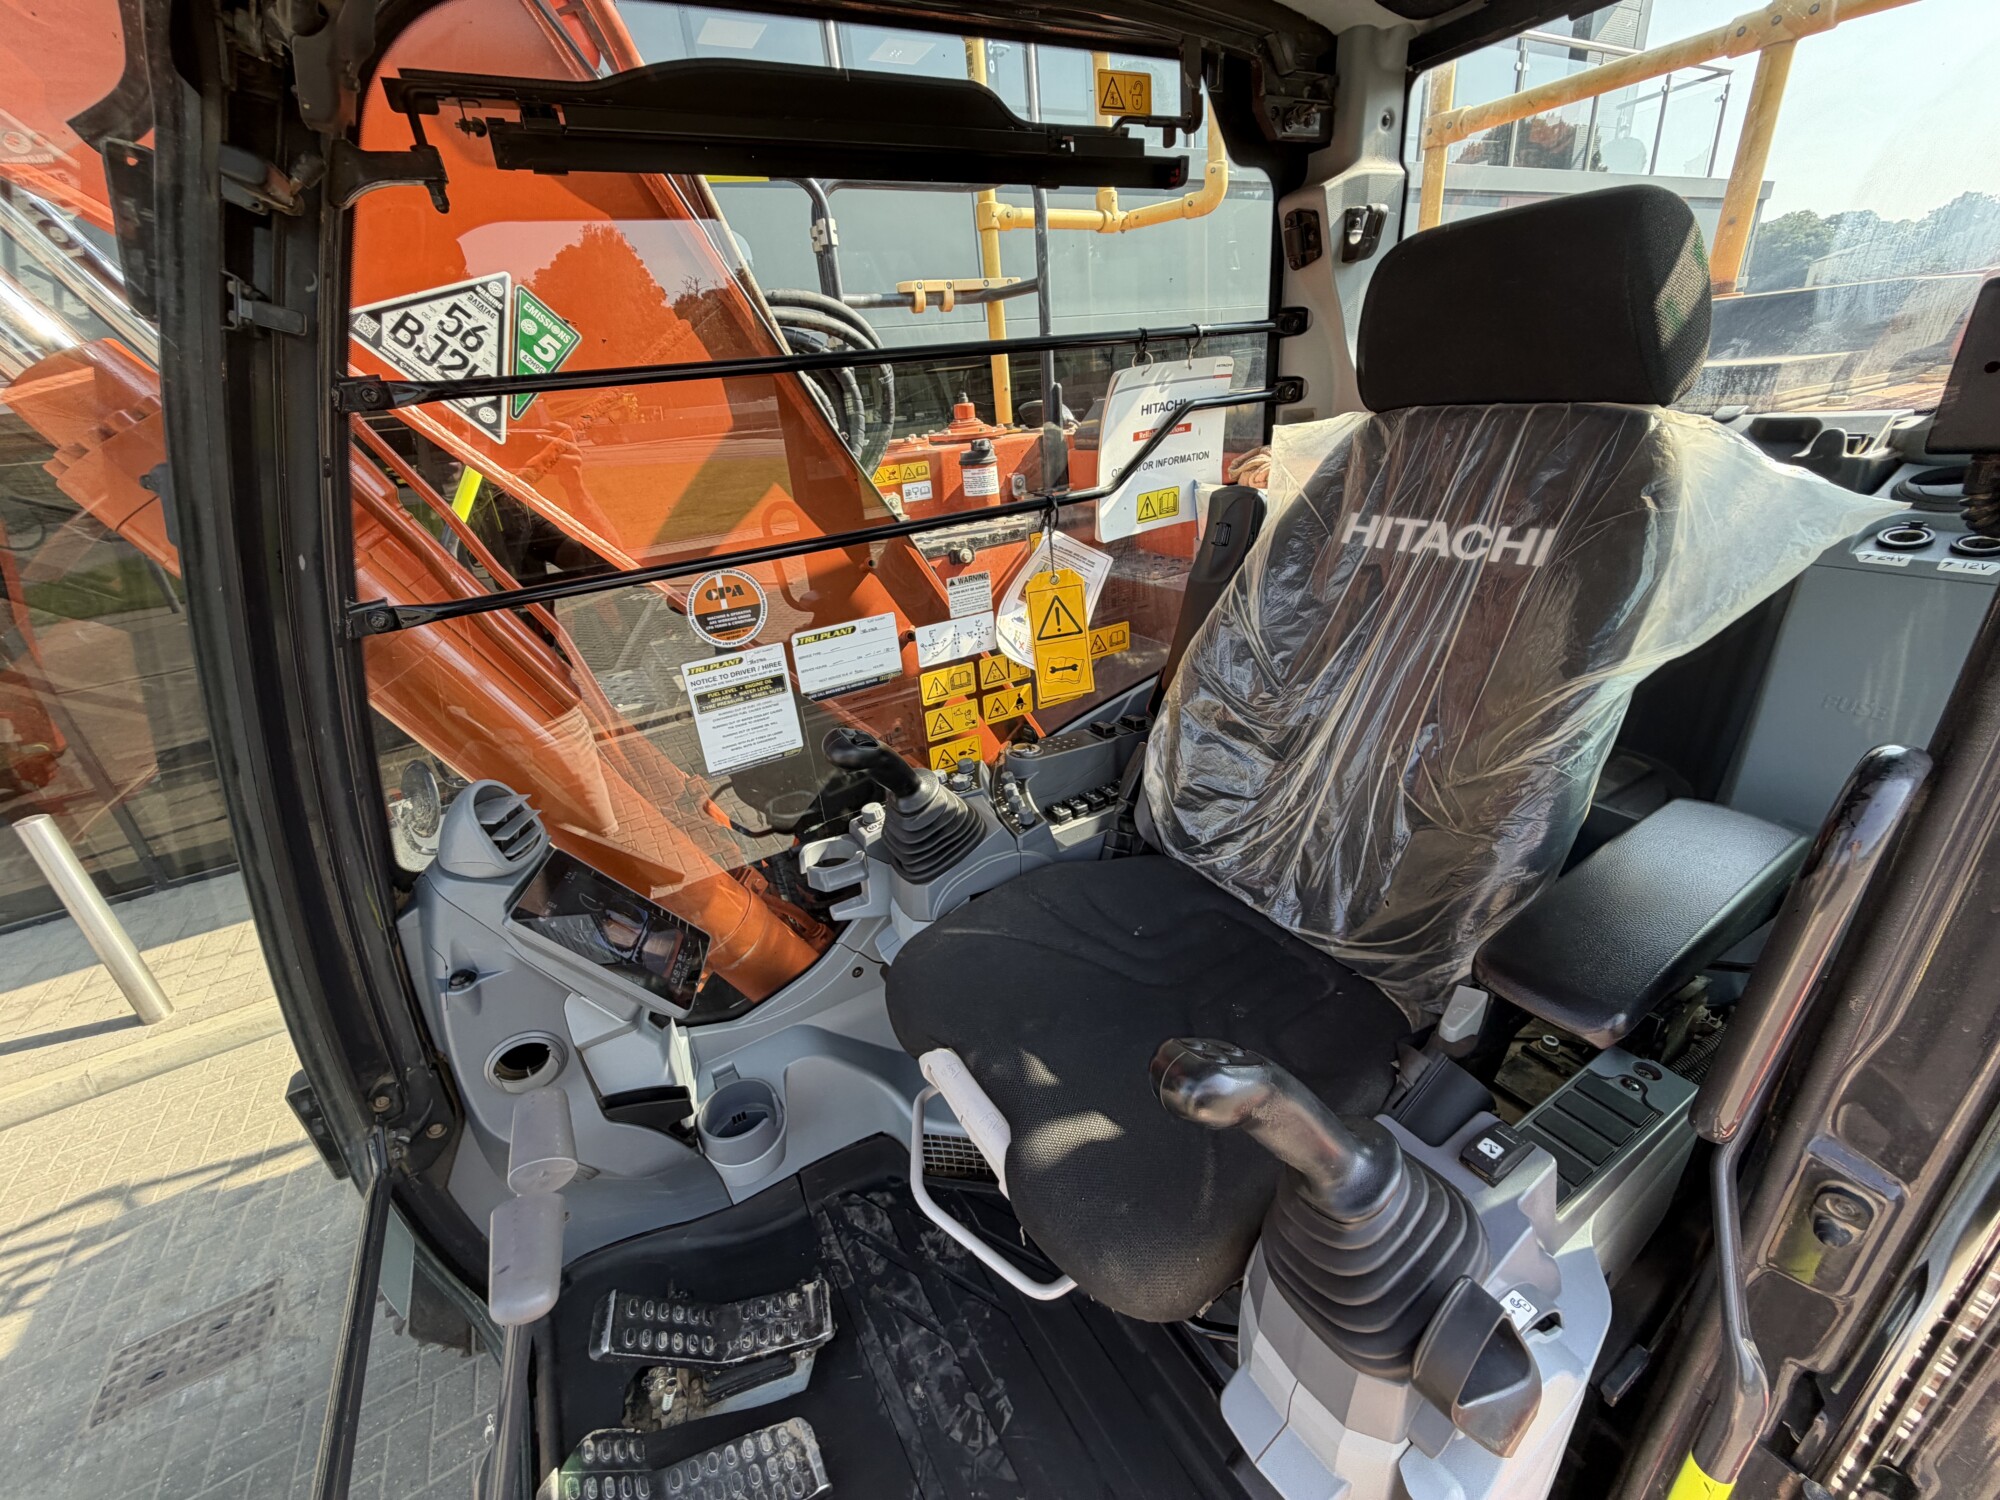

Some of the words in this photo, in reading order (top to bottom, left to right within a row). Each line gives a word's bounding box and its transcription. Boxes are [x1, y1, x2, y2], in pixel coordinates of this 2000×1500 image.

[474, 285, 505, 310] WARNING
[466, 294, 498, 320] DATATAG
[438, 303, 489, 352] 56
[523, 302, 571, 344] EMISSIONS
[533, 334, 562, 362] 5
[1155, 451, 1210, 469] INFORMATION
[1341, 512, 1557, 567] HITACHI
[1877, 554, 1906, 563] 24V
[1961, 562, 1993, 571] 12V
[957, 573, 989, 584] WARNING
[705, 585, 744, 601] CPA
[799, 635, 820, 645] TRU
[820, 627, 853, 640] PLANT
[690, 665, 709, 675] TRU
[709, 658, 740, 670] PLANT
[690, 676, 718, 687] NOTICE
[730, 667, 756, 677] DRIVER
[761, 661, 782, 670] HIREE
[745, 681, 764, 689] ENGINE
[711, 695, 732, 703] GREASE
[1821, 695, 1888, 721] FUSE
